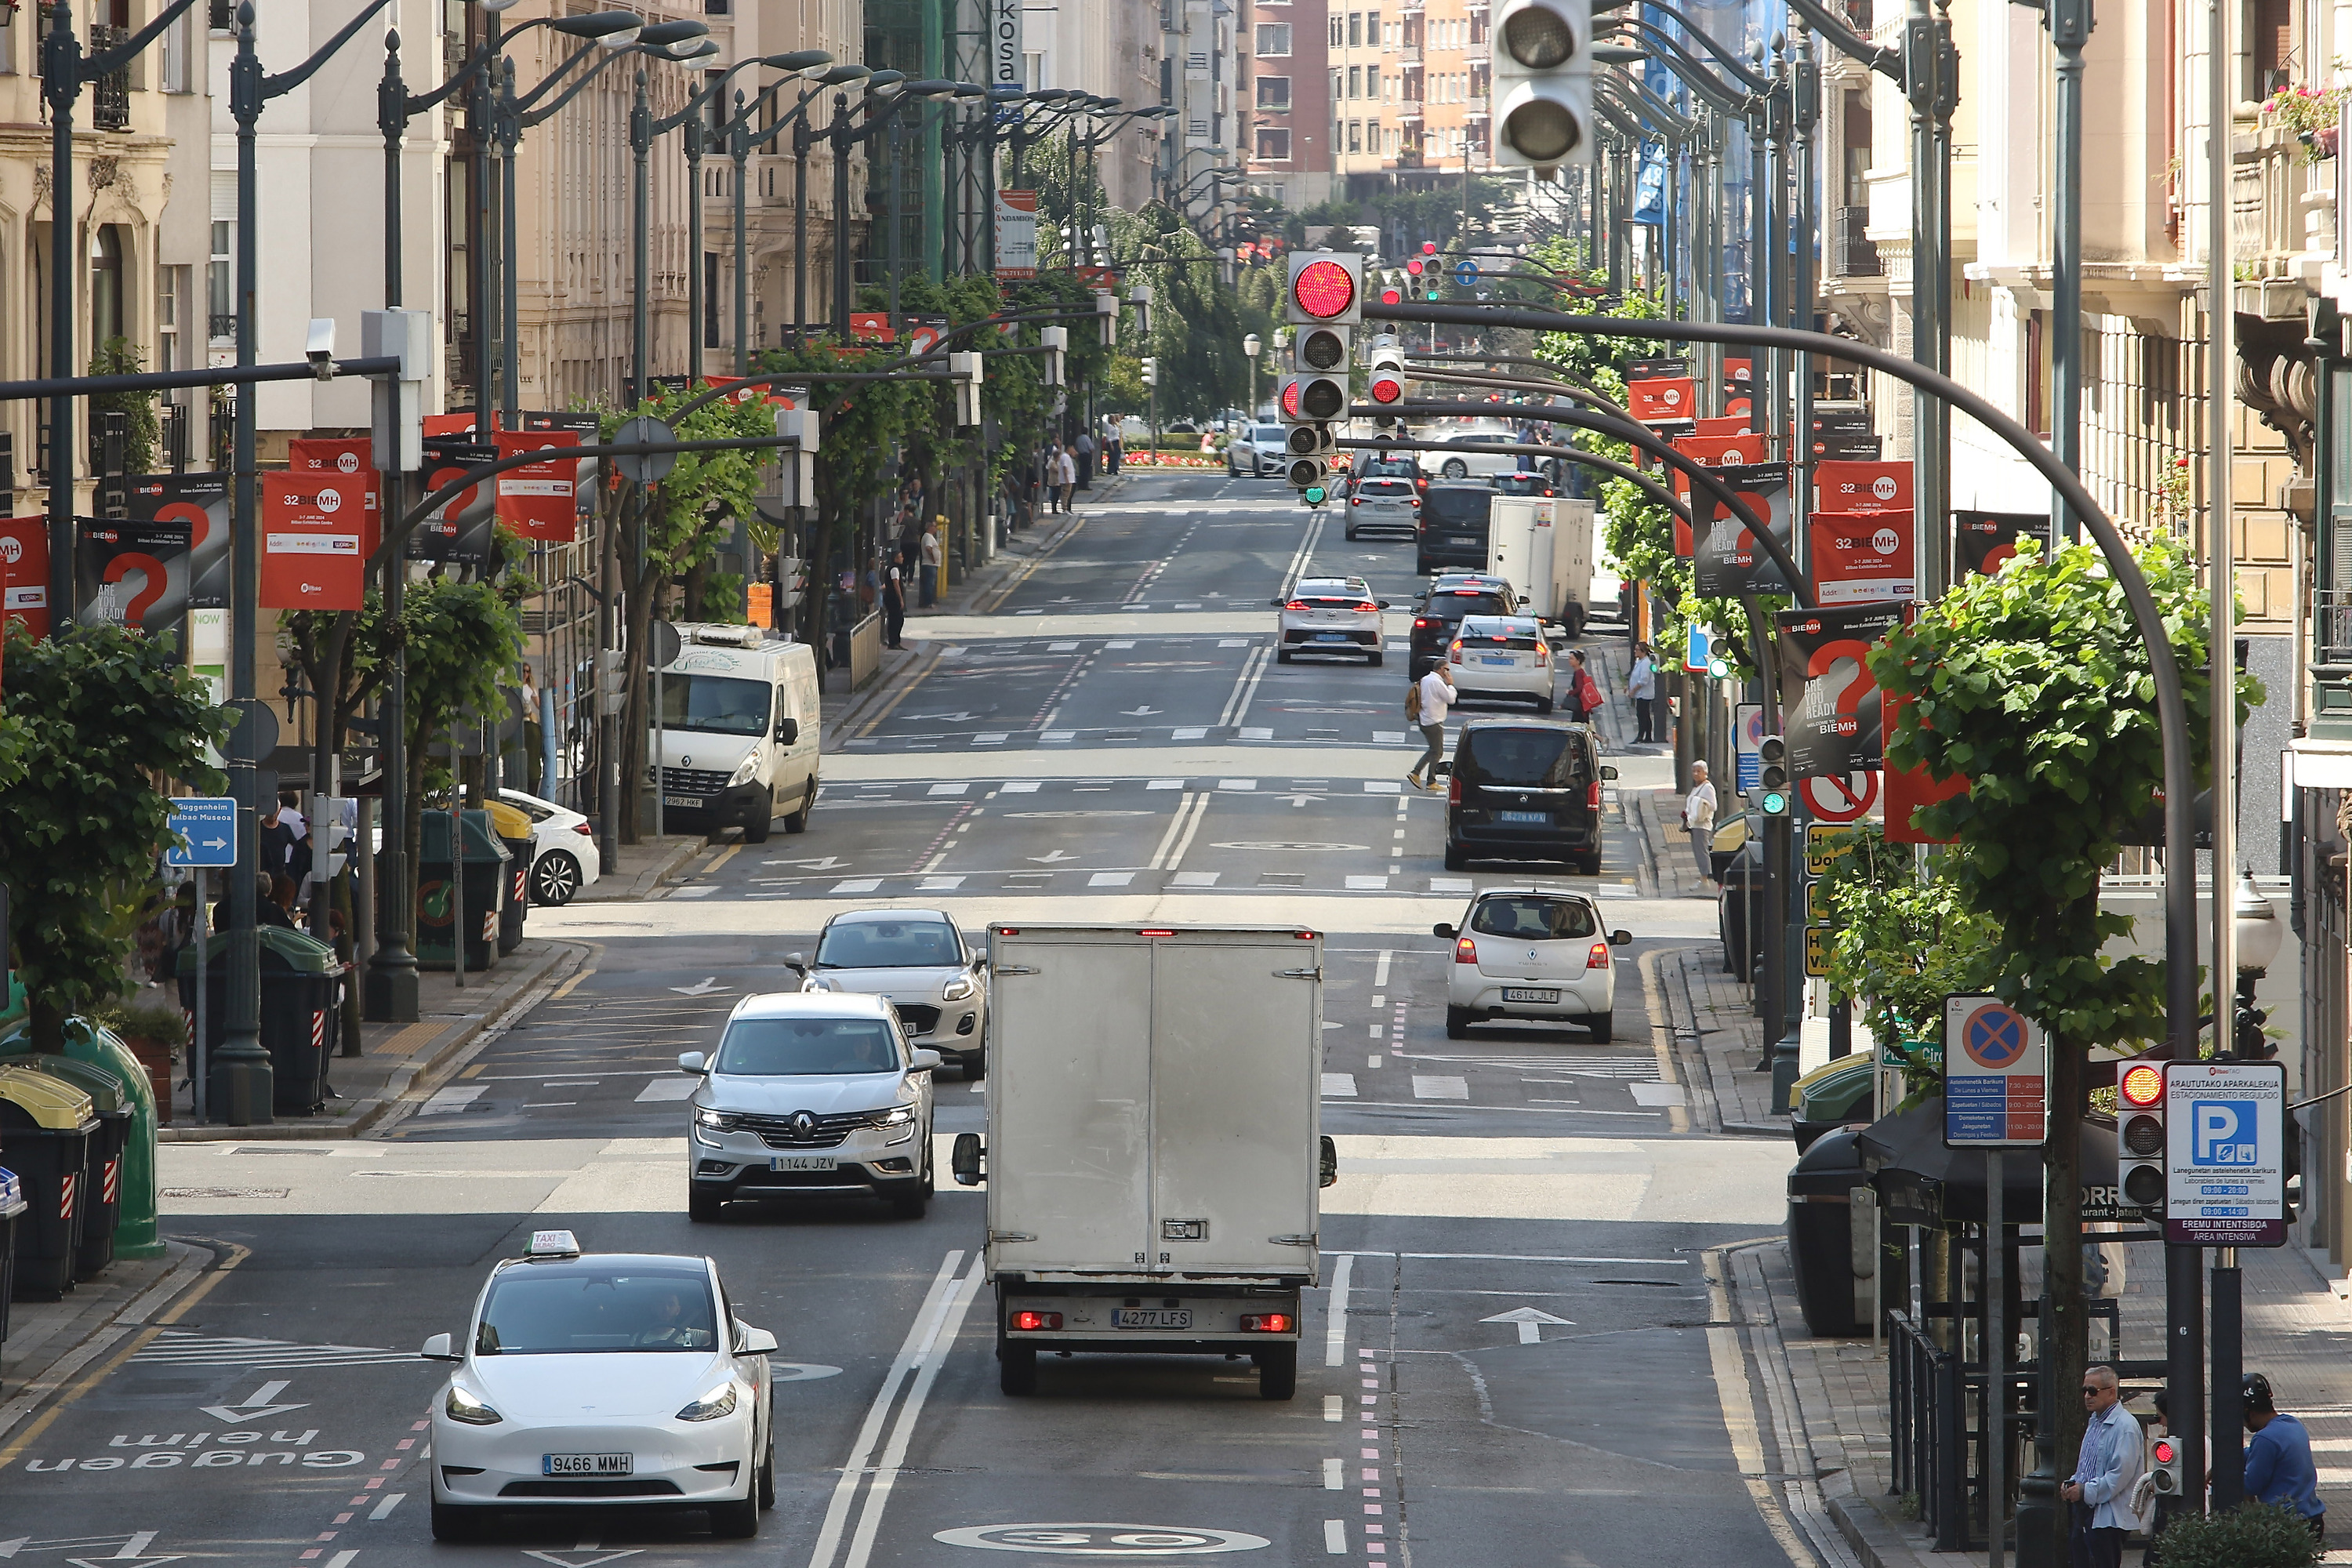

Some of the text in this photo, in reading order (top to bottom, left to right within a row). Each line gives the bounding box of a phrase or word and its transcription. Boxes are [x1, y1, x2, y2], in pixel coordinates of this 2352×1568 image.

[1641, 168, 1663, 186] 48
[1643, 394, 1678, 402] 32BIEMH
[308, 459, 357, 469] 32BIEMH
[1840, 483, 1894, 493] 32BIEMH
[284, 495, 338, 506] 32BIEMH
[1711, 521, 1726, 532] ARE
[1711, 532, 1726, 542] YOU
[1835, 536, 1896, 549] 32BIEMH
[1712, 540, 1737, 551] READY
[1723, 556, 1752, 564] BIEMH
[98, 584, 115, 597] ARE
[98, 596, 115, 608] YOU
[97, 608, 125, 619] READY
[1781, 622, 1820, 633] 32BIEMH
[1805, 678, 1822, 694] ARE
[1806, 691, 1824, 706] YOU
[1806, 702, 1836, 720] READY
[1807, 720, 1828, 728] WELCOME
[1820, 721, 1857, 734] BIEMH
[1510, 990, 1555, 1000] 4614 JLF
[2198, 1105, 2239, 1158] P
[779, 1158, 834, 1170] 1144 JZV
[2183, 1220, 2267, 1229] EREMU INTENTSIBOA
[2194, 1231, 2256, 1240] ÁREA INTENSIVA
[1122, 1312, 1188, 1325] 4277 LFS
[2180, 1327, 2187, 1335] 6
[108, 1429, 320, 1449] heim
[24, 1450, 366, 1472] Guggen
[554, 1456, 628, 1471] 9466 MMH
